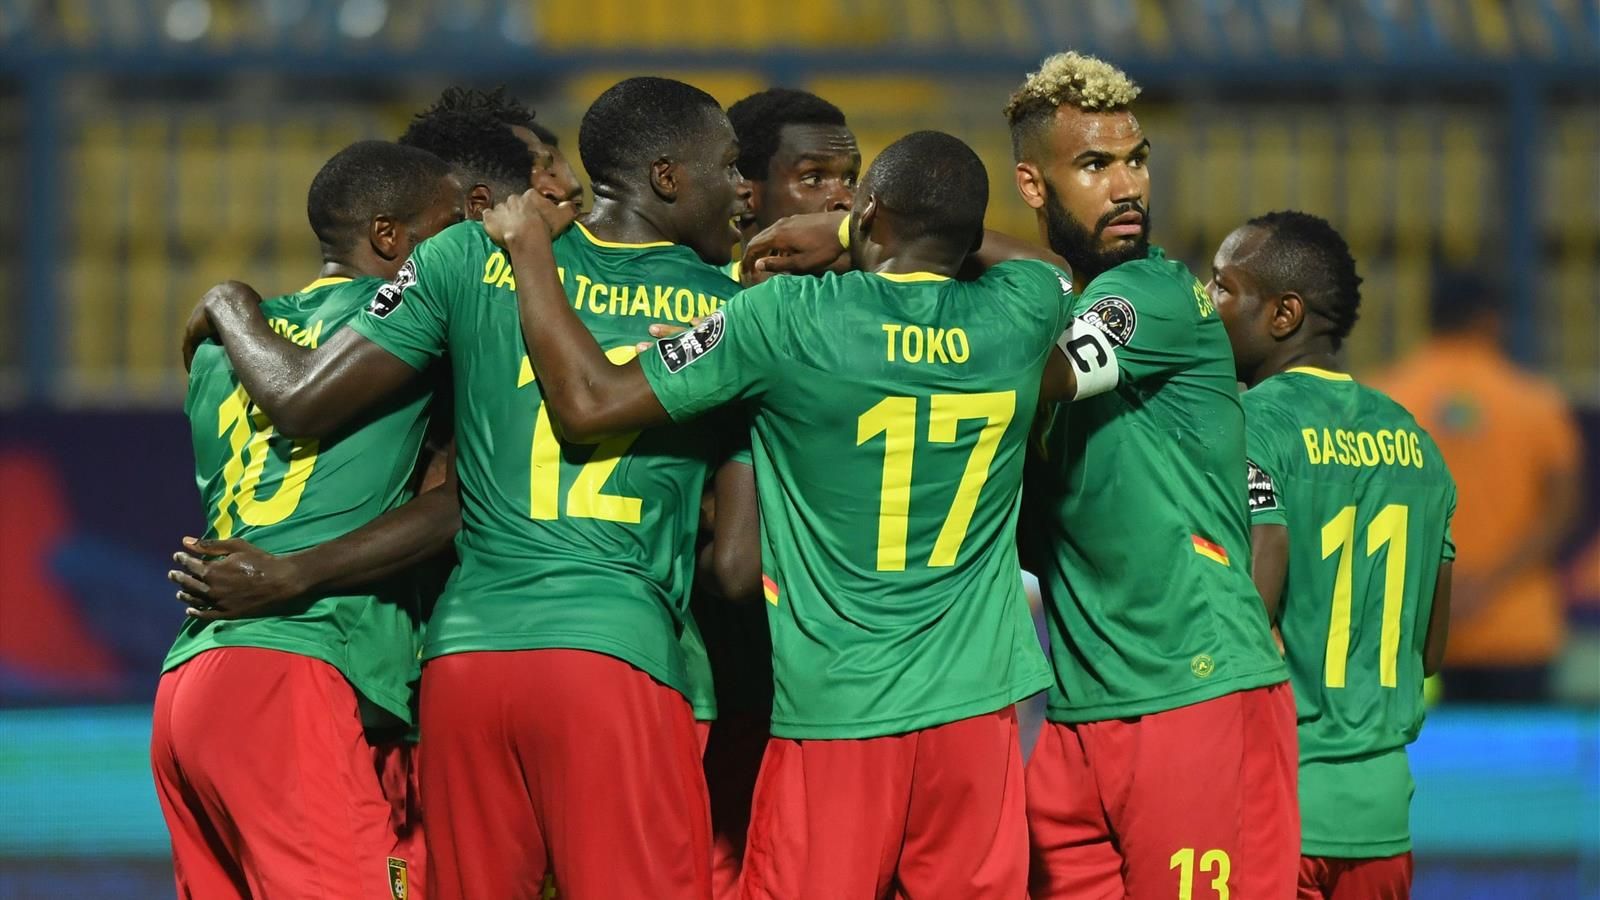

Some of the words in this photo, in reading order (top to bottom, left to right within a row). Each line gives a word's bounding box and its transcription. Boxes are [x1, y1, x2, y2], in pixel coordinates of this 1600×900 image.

[574, 274, 727, 323] TCHAKON
[881, 323, 970, 364] TOKO
[1066, 334, 1108, 373] C
[213, 384, 320, 540] 10
[1302, 428, 1424, 469] BASSOGOG
[857, 390, 1017, 571] 17
[1321, 504, 1409, 688] 11
[1169, 847, 1231, 900] 13
